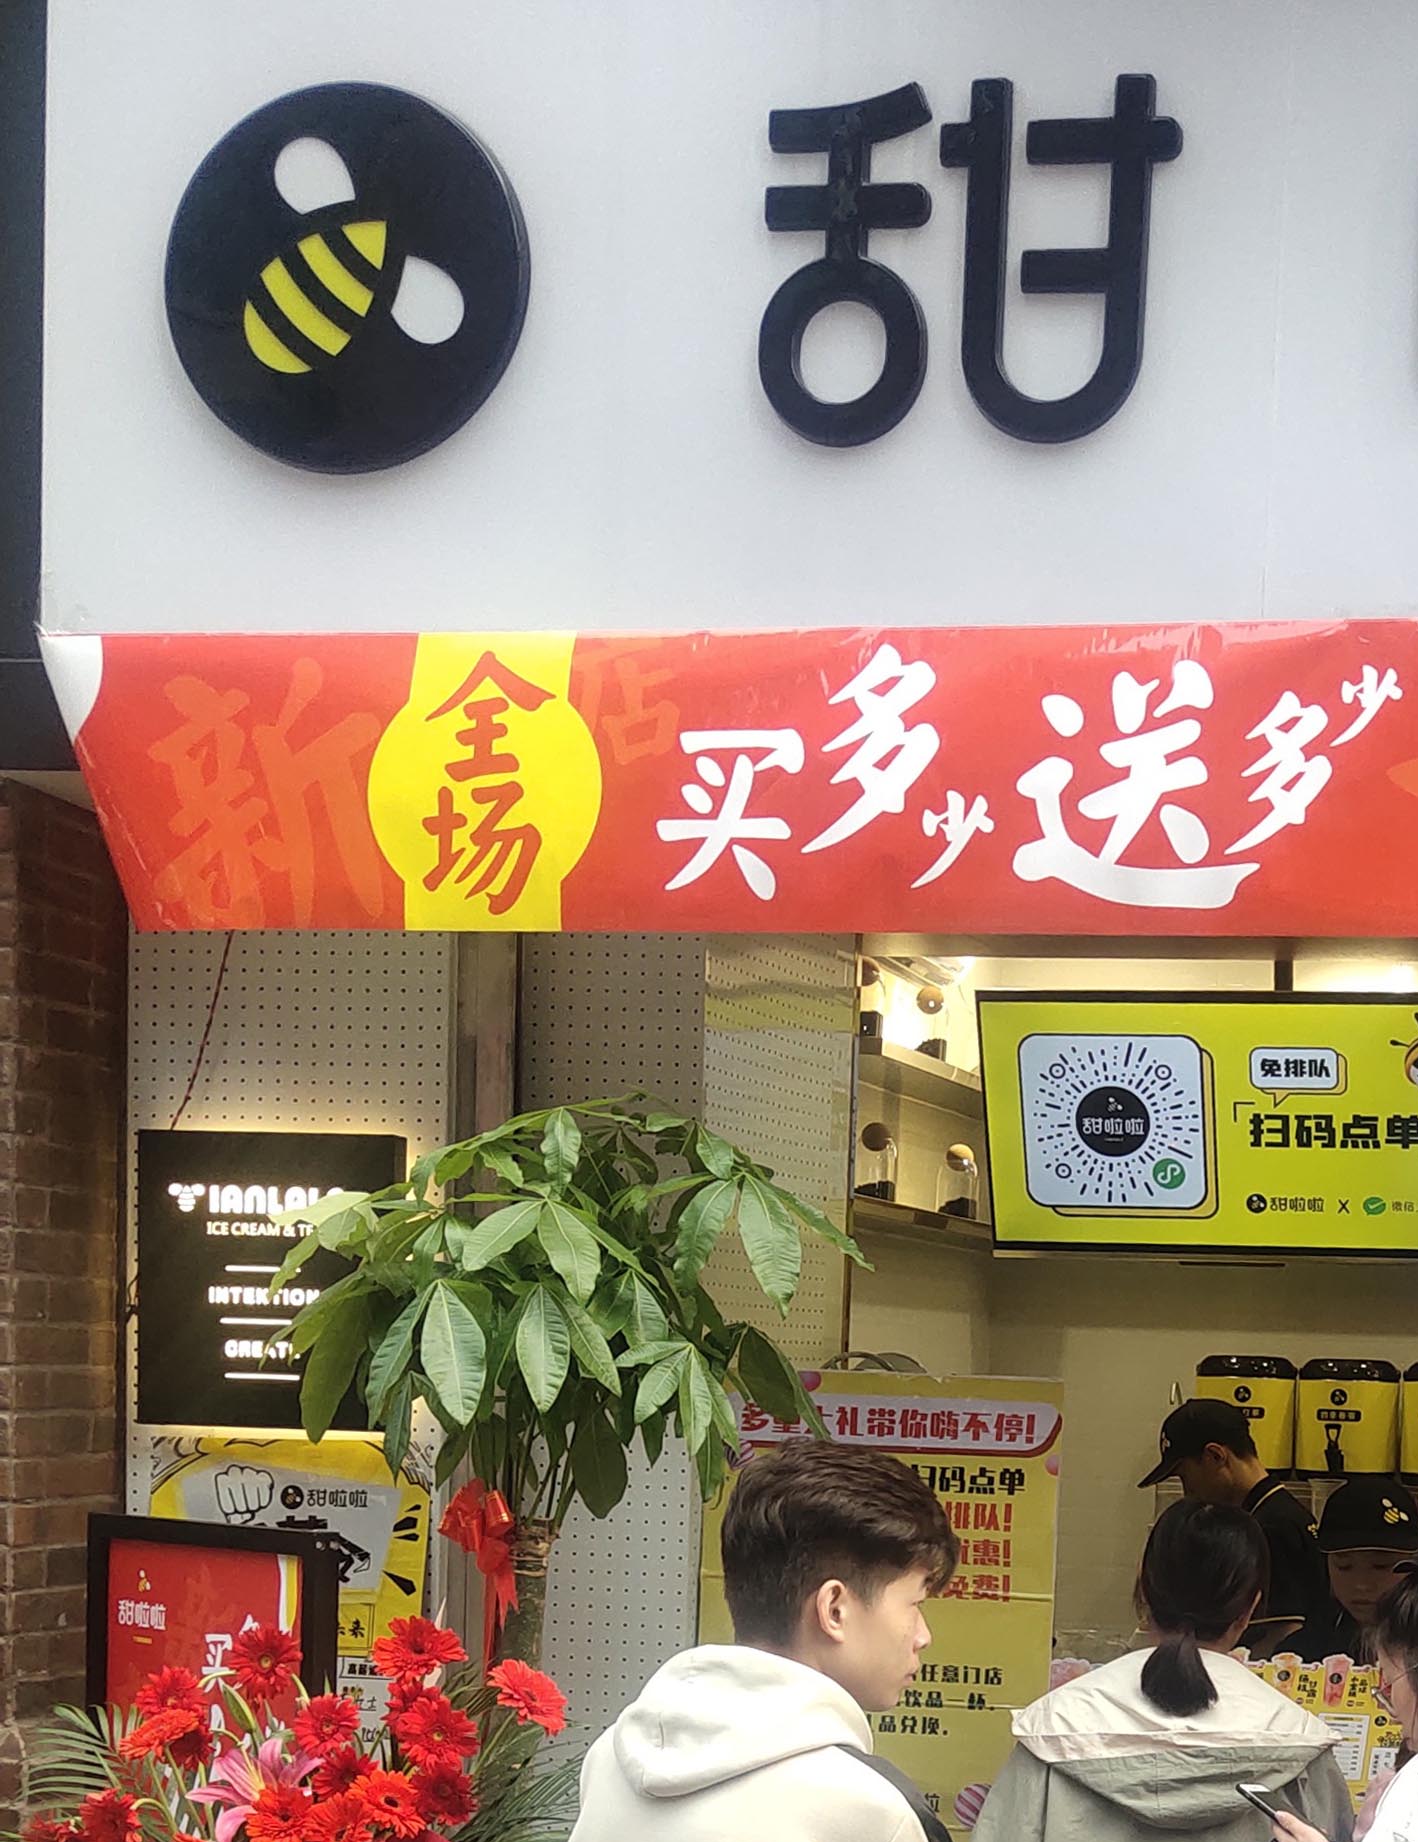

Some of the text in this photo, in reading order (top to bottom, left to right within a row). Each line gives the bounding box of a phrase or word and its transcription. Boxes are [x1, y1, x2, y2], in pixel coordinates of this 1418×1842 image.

[422, 651, 557, 916] 全场
[1260, 1057, 1331, 1079] 免排队
[1082, 1117, 1145, 1135] 甜啦啦
[1270, 1197, 1324, 1212] 甜啦啦
[206, 1221, 229, 1236] ICE
[231, 1221, 281, 1237] CREAM
[283, 1223, 296, 1238] &
[307, 1489, 368, 1508] 甜啦啦
[118, 1599, 167, 1631] 甜啦啦
[911, 1664, 1003, 1685] 任意门店
